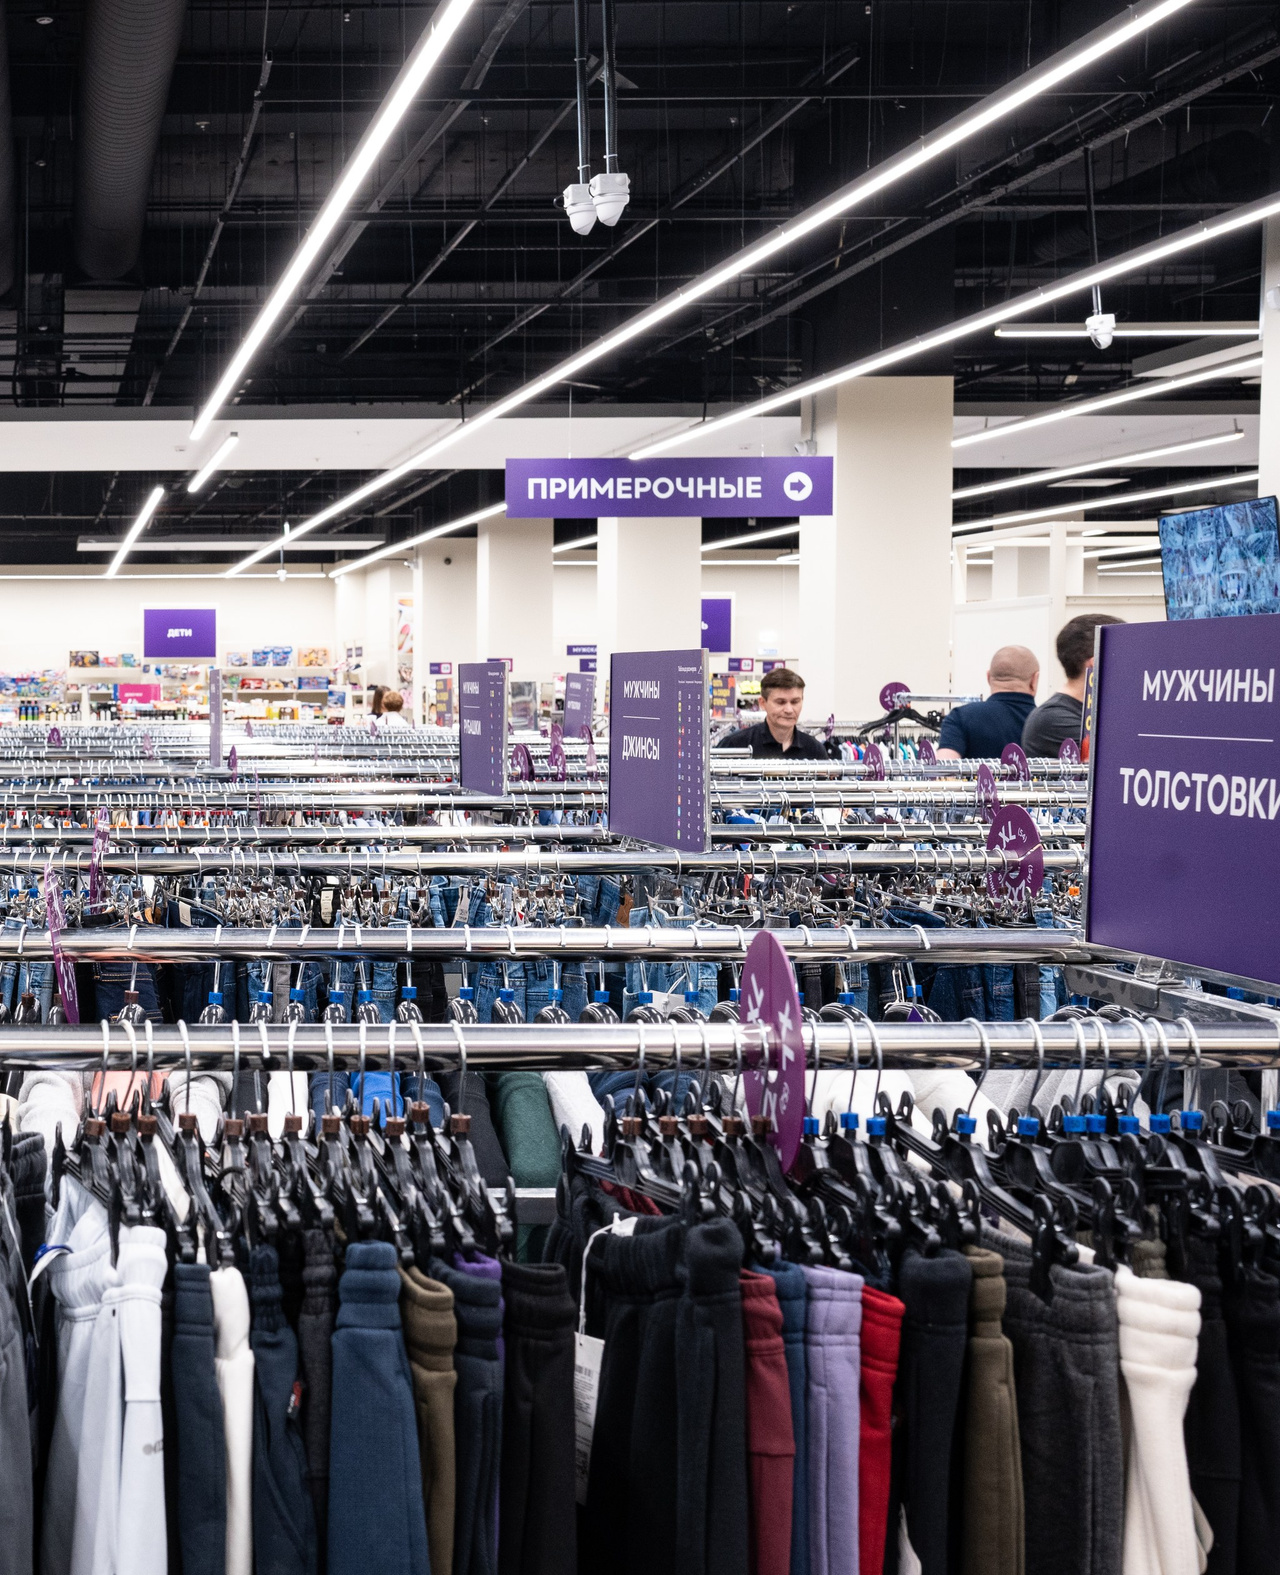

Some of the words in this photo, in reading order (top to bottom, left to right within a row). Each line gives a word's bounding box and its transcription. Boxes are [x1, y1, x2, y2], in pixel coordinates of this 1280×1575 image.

[528, 476, 762, 500] ПРИМЕРОЧНЫЕ
[167, 628, 192, 638] ДЕТИ
[623, 680, 660, 699] МУЖЧИНЫ
[1143, 668, 1275, 703] МУЖЧИНЫ
[622, 735, 660, 761] ДЖИНСЫ
